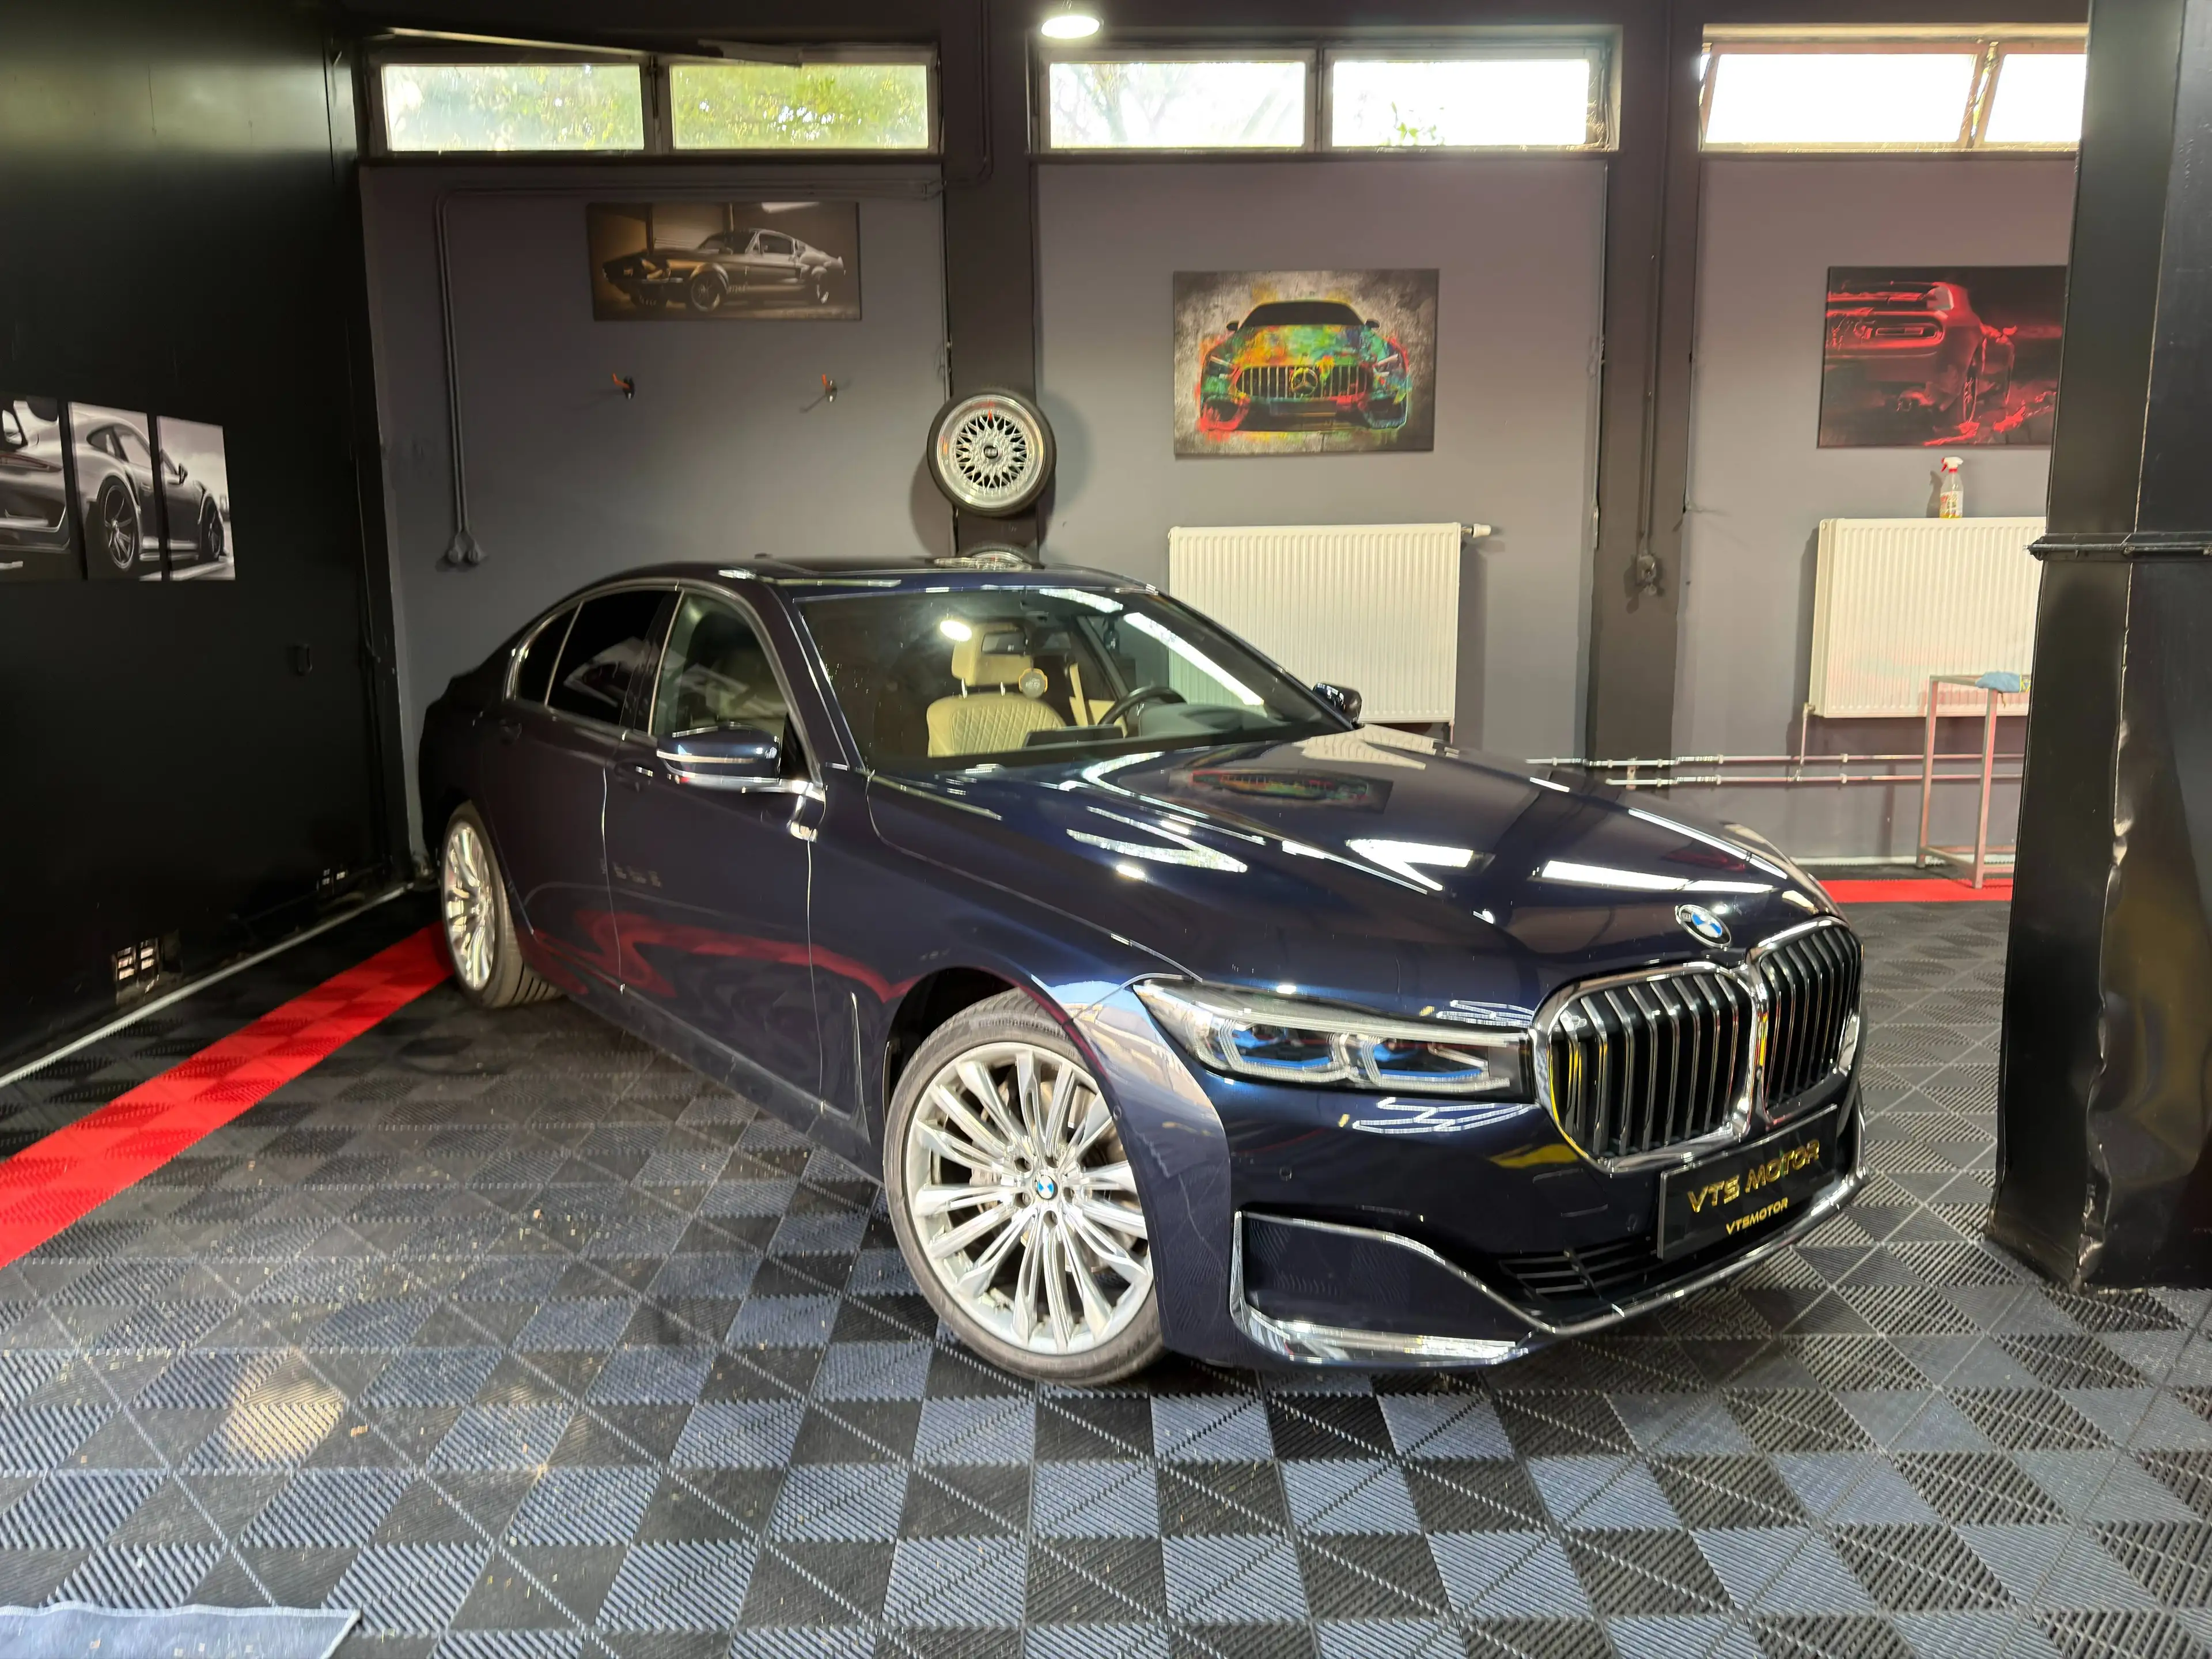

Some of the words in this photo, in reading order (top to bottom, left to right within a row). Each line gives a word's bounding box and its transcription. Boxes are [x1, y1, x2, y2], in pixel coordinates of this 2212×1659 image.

[1688, 1175, 1740, 1213] VTS
[1745, 1139, 1820, 1193] MOTOR
[1726, 1197, 1788, 1235] VTSMOTOR
